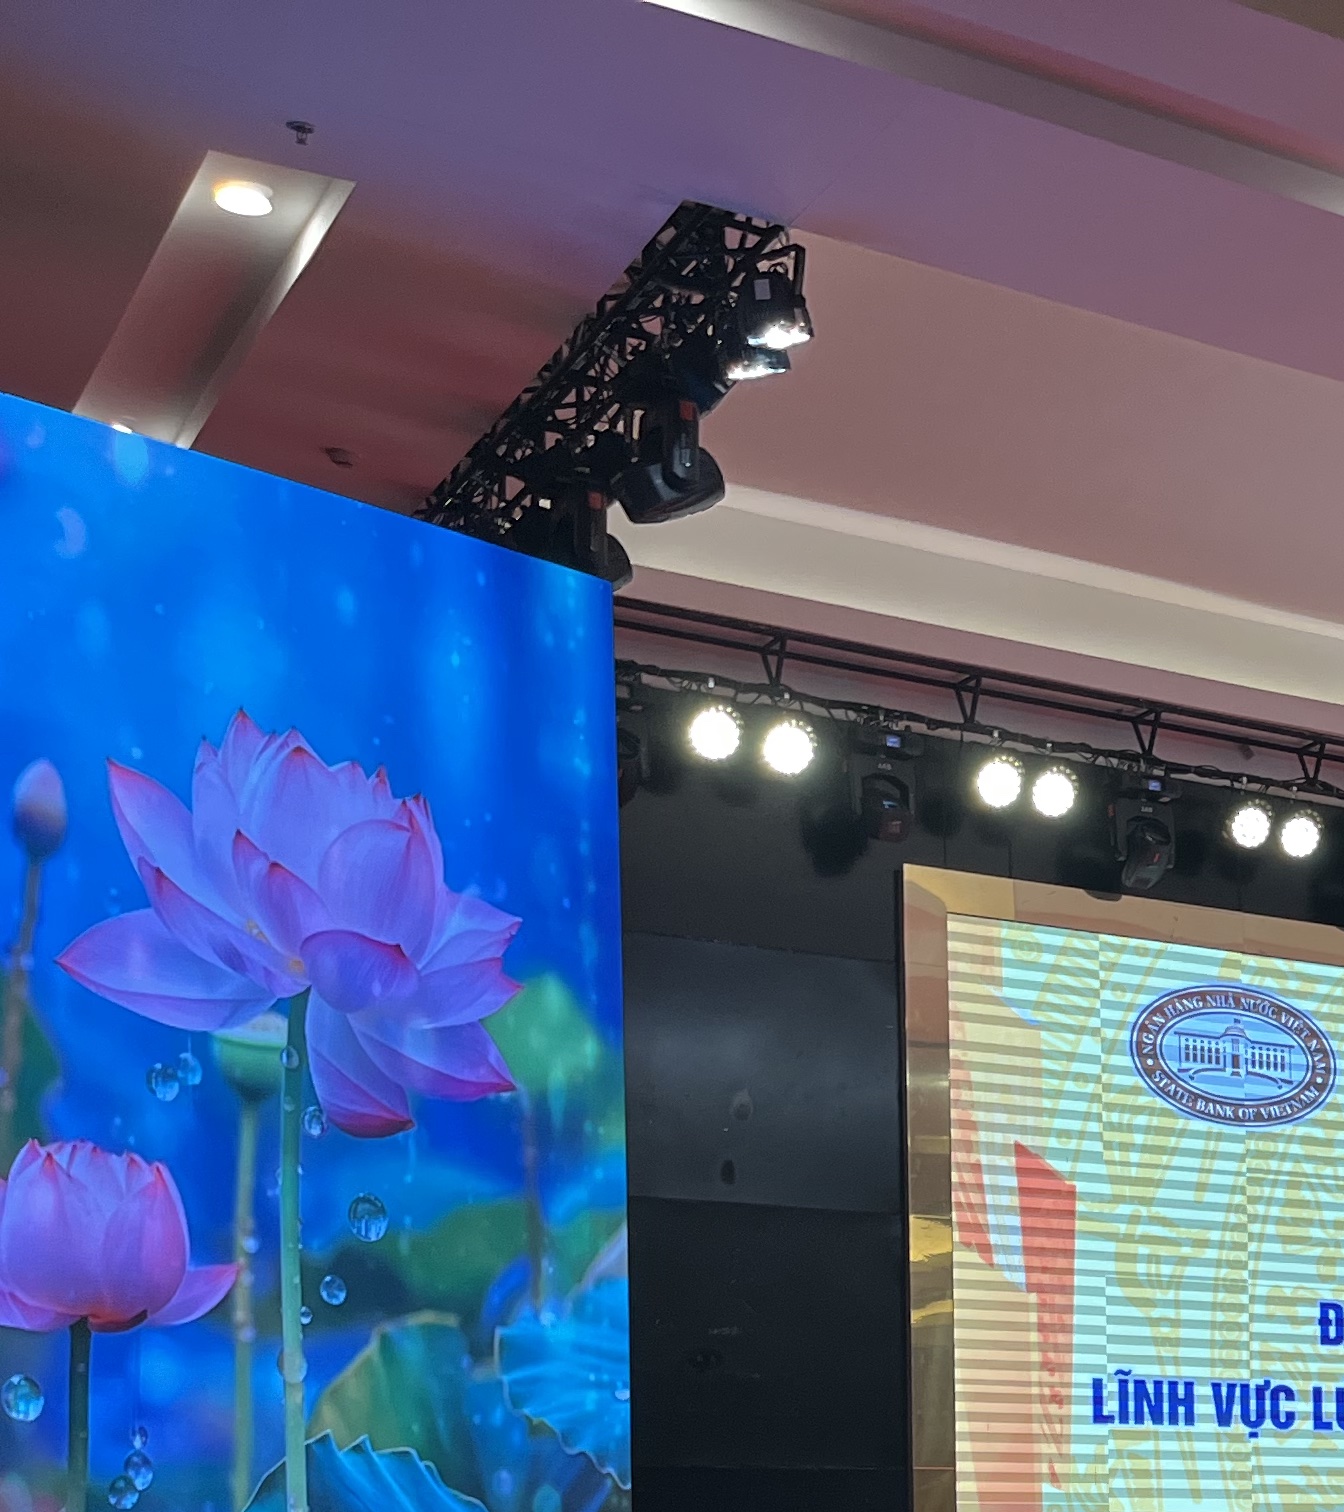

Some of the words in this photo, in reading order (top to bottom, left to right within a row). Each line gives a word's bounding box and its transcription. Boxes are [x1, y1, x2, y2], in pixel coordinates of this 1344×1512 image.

[1307, 1039, 1327, 1075] NAM
[1152, 1069, 1195, 1109] STATE
[1195, 1099, 1236, 1120] BANK
[1238, 1106, 1258, 1121] OF
[1259, 1085, 1321, 1121] VIETNAM
[1092, 1369, 1195, 1426] LĨNH
[1210, 1379, 1296, 1439] VỰC
